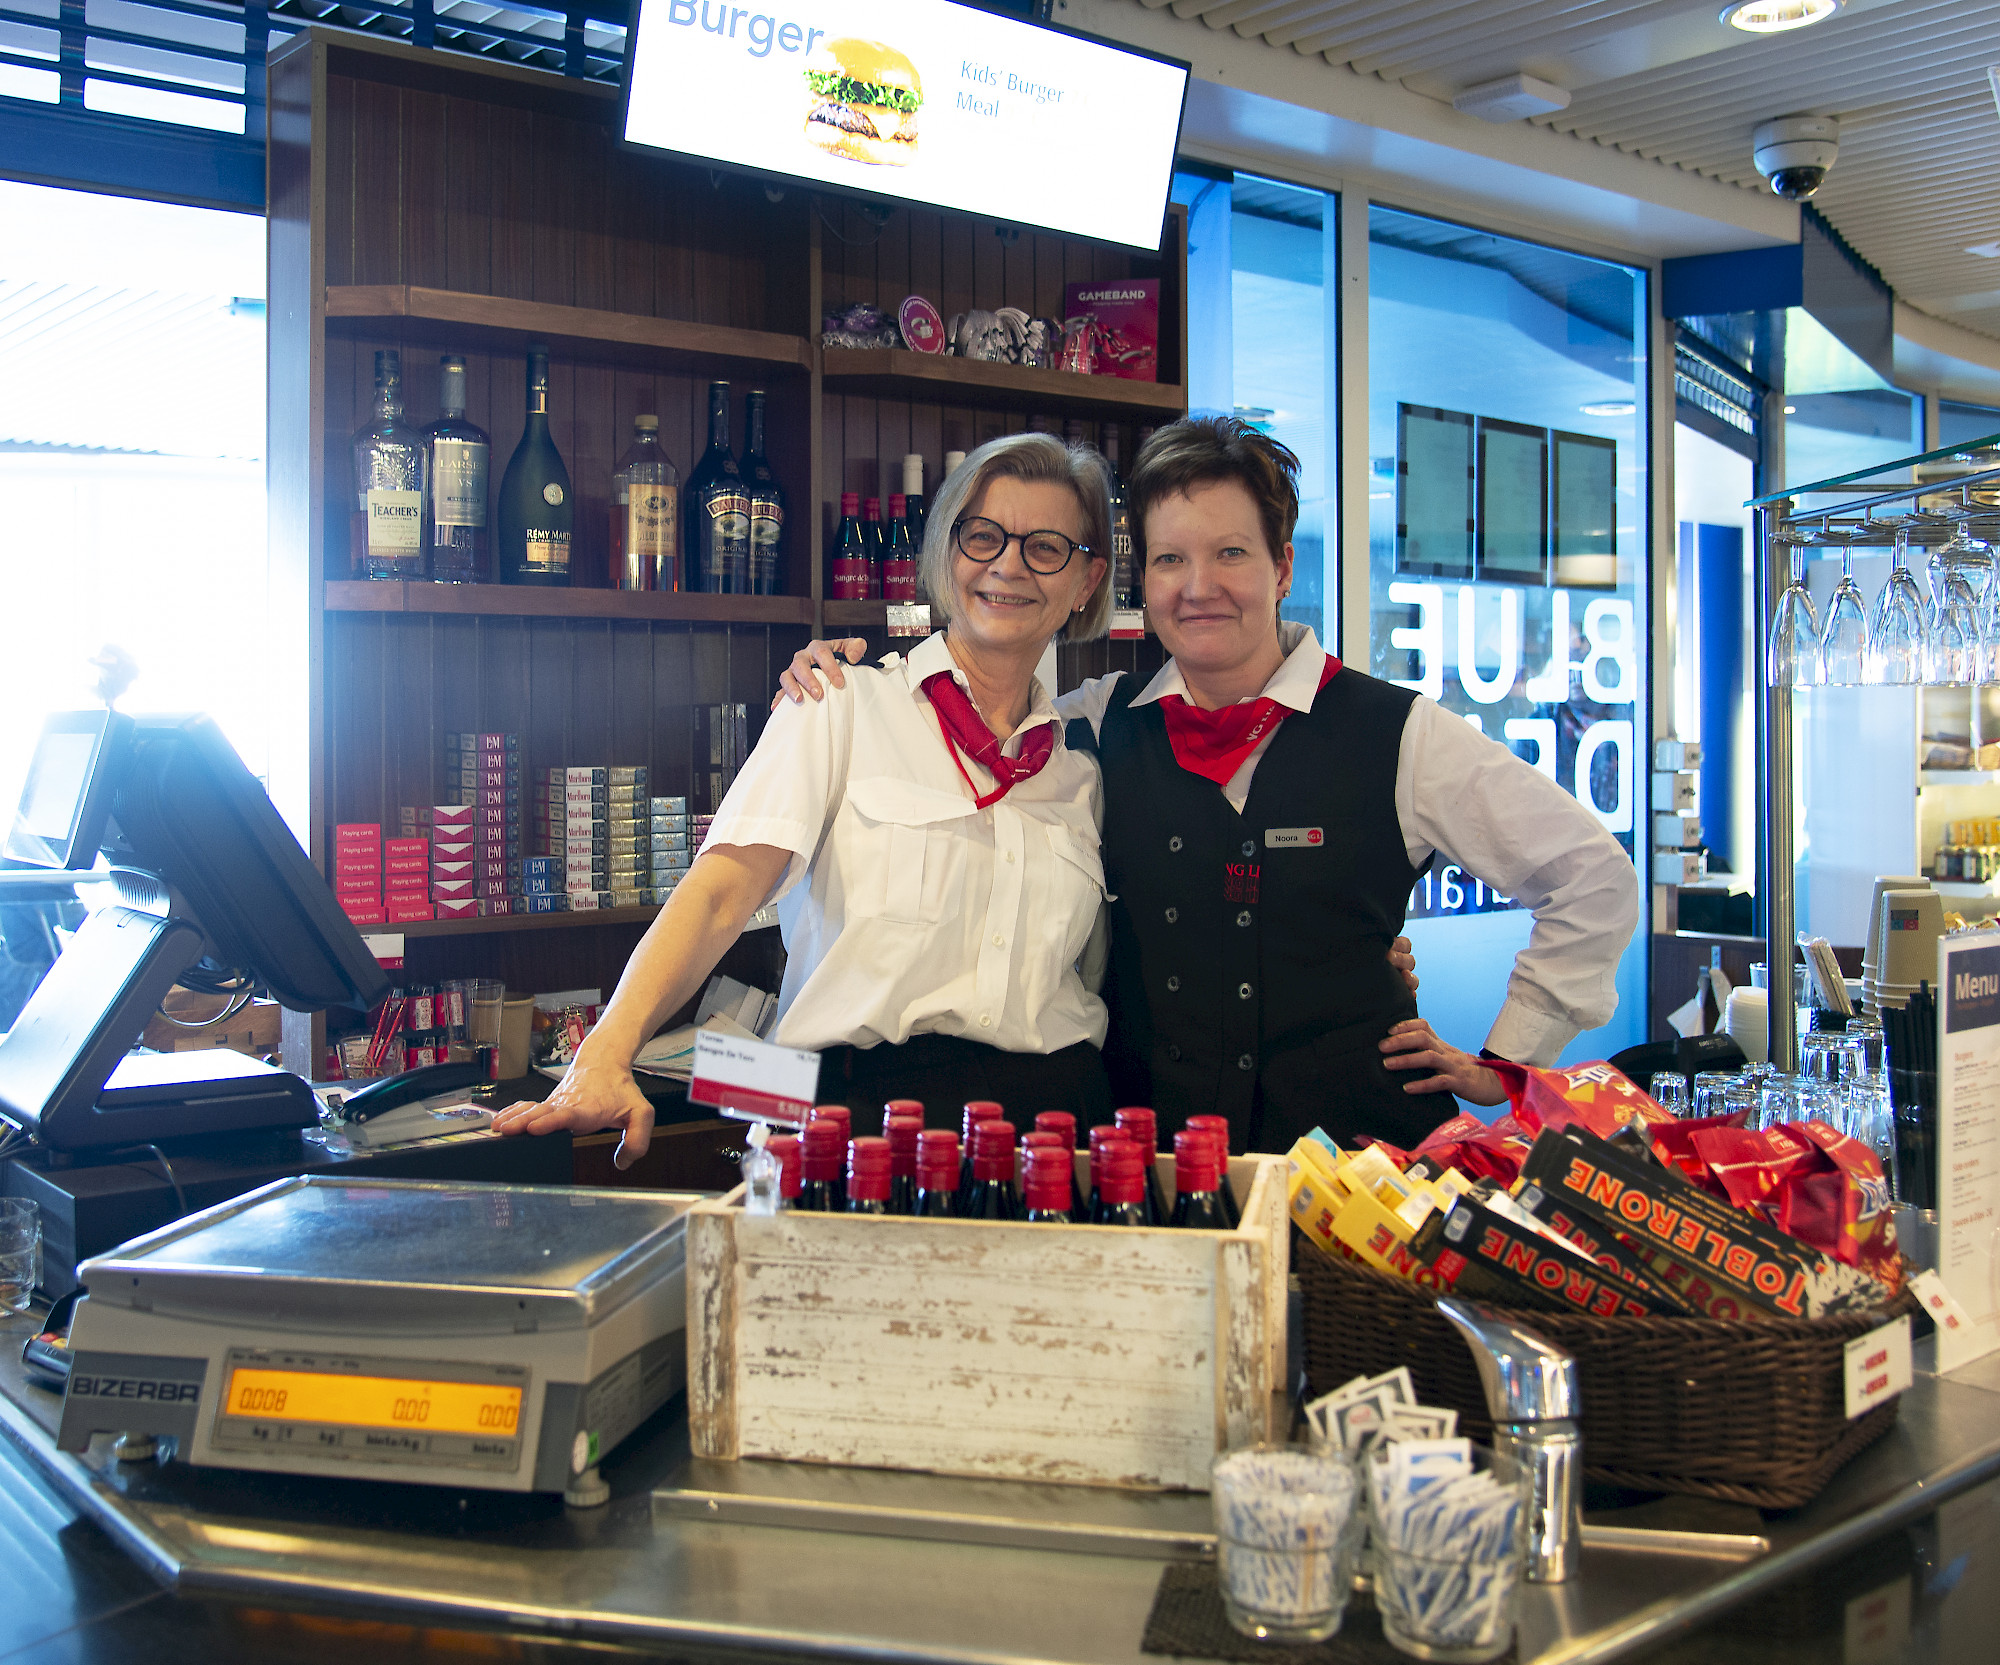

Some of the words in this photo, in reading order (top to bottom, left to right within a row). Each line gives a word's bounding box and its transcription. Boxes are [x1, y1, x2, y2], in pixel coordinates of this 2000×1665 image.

[668, 0, 825, 58] Burger
[1007, 73, 1064, 104] Burger
[956, 91, 1000, 118] Meal
[1078, 290, 1146, 301] GAMEBAND
[371, 502, 419, 518] TEACHER'S
[568, 771, 592, 783] Marlboro
[567, 789, 591, 801] Marlboro
[568, 807, 591, 818] Marlboro
[568, 825, 592, 837] Marlboro
[1275, 834, 1298, 843] Noora
[568, 842, 592, 853] Marlboro
[568, 860, 591, 872] Marlboro
[568, 878, 591, 890] Marlboro
[575, 896, 598, 908] Marlboro
[1955, 972, 1999, 1000] Menu
[1563, 1156, 1808, 1317] TOBLERONE
[72, 1376, 200, 1403] BIZERBA
